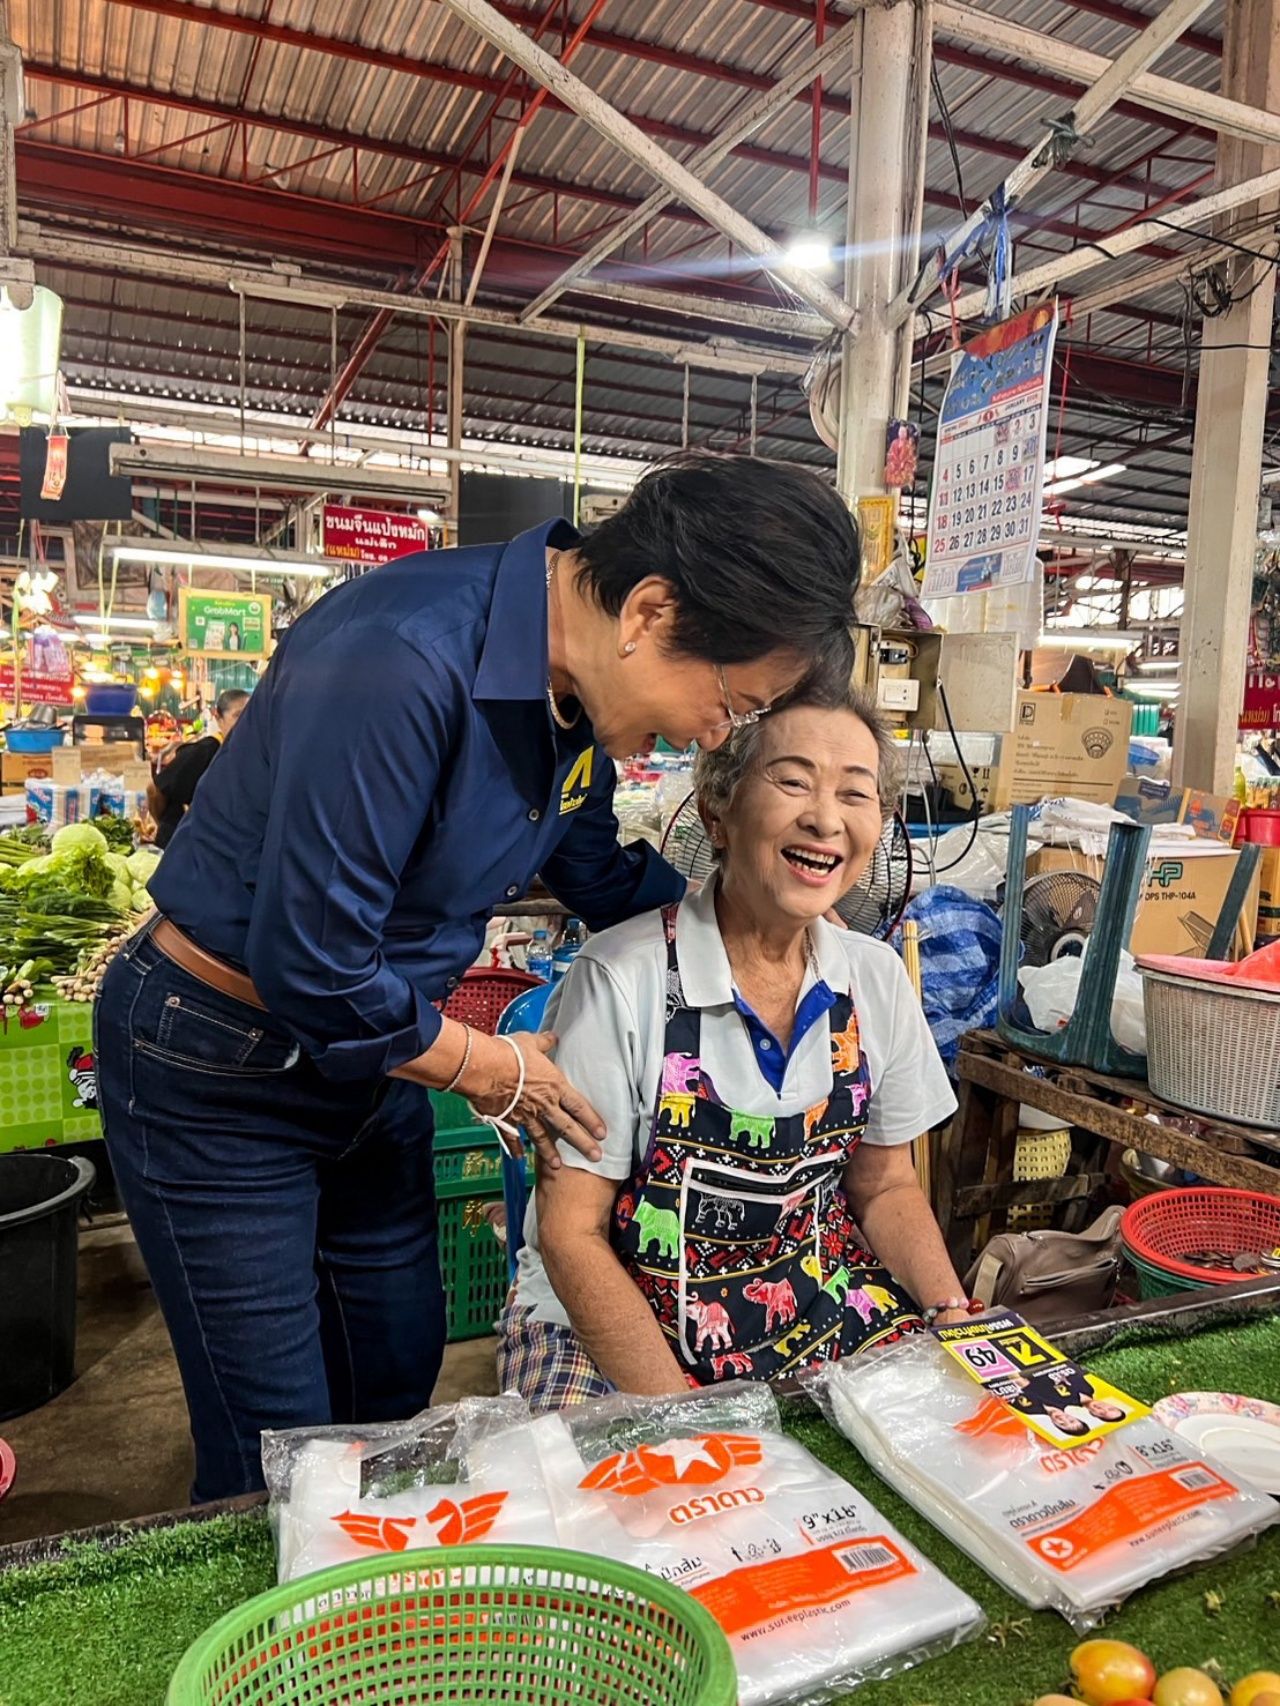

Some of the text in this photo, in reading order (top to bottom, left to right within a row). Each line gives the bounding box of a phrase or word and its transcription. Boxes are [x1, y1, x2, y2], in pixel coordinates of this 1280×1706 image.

[1029, 413, 1036, 430] 3
[943, 470, 948, 481] 4
[956, 464, 961, 479] 5
[969, 460, 975, 475] 6
[983, 455, 989, 470] 7
[997, 449, 1004, 465] 8
[1012, 445, 1019, 461] 9
[939, 491, 949, 507] 11
[953, 487, 963, 502] 12
[966, 483, 976, 499] 13
[980, 478, 990, 494] 14
[994, 474, 1004, 491] 15
[1023, 464, 1035, 482] 17
[325, 514, 426, 541] ขนมจีนแป้งหมัก
[937, 491, 1032, 530] 18 19 20 21 22 23 24
[934, 517, 1029, 553] 25 26 27 28 29 30 31
[204, 605, 246, 617] GrabMart
[965, 1347, 998, 1368] 49
[668, 1486, 766, 1525] ตราดาว
